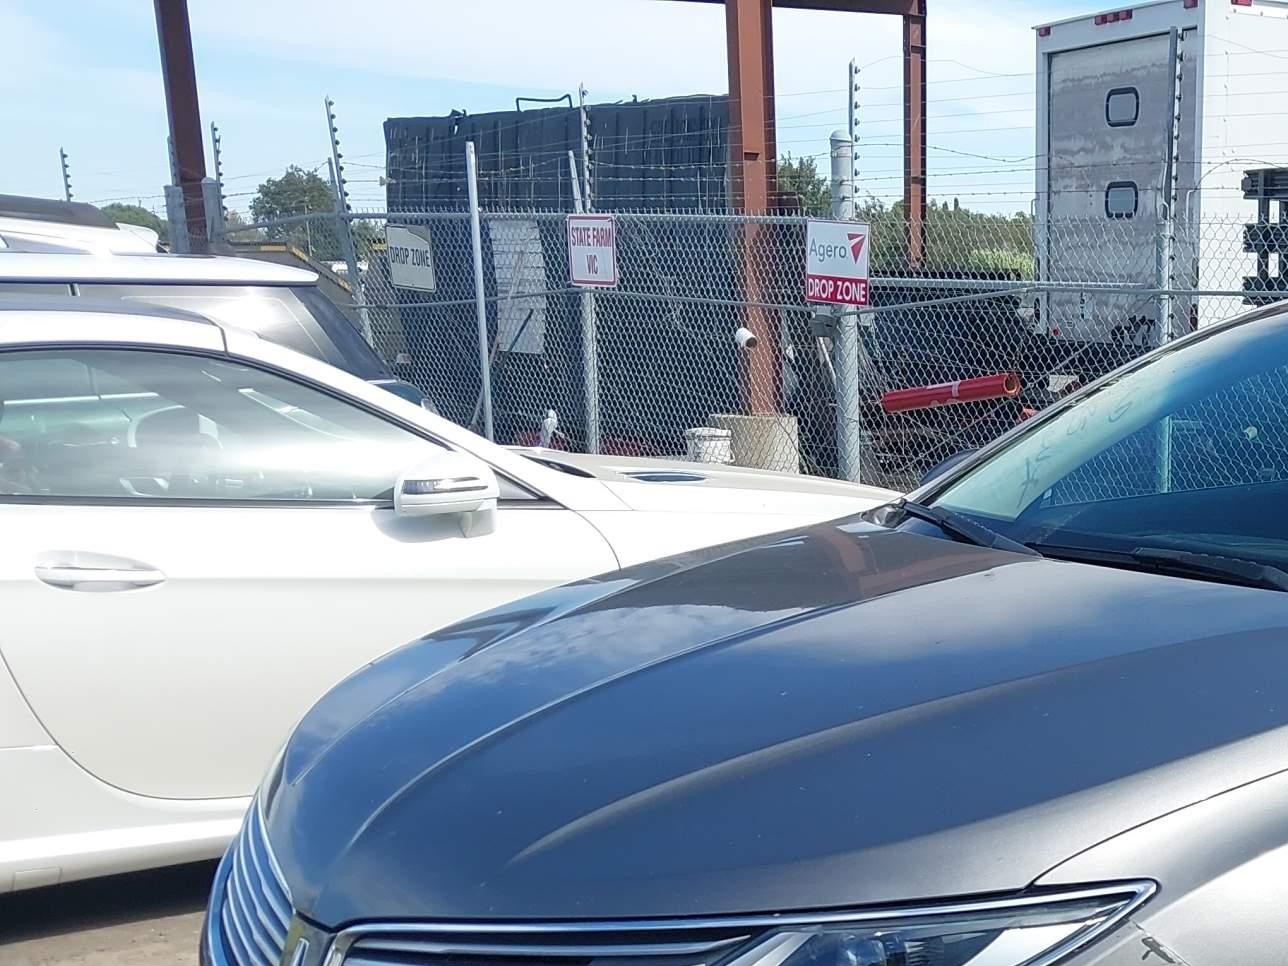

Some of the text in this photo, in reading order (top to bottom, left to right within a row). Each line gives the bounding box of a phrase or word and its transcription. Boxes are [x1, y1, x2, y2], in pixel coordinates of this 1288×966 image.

[571, 226, 612, 247] STATE FARM
[389, 246, 431, 268] DROP ZONE
[809, 238, 847, 262] Agero
[586, 254, 598, 274] VIC
[808, 278, 866, 302] DROP ZONE
